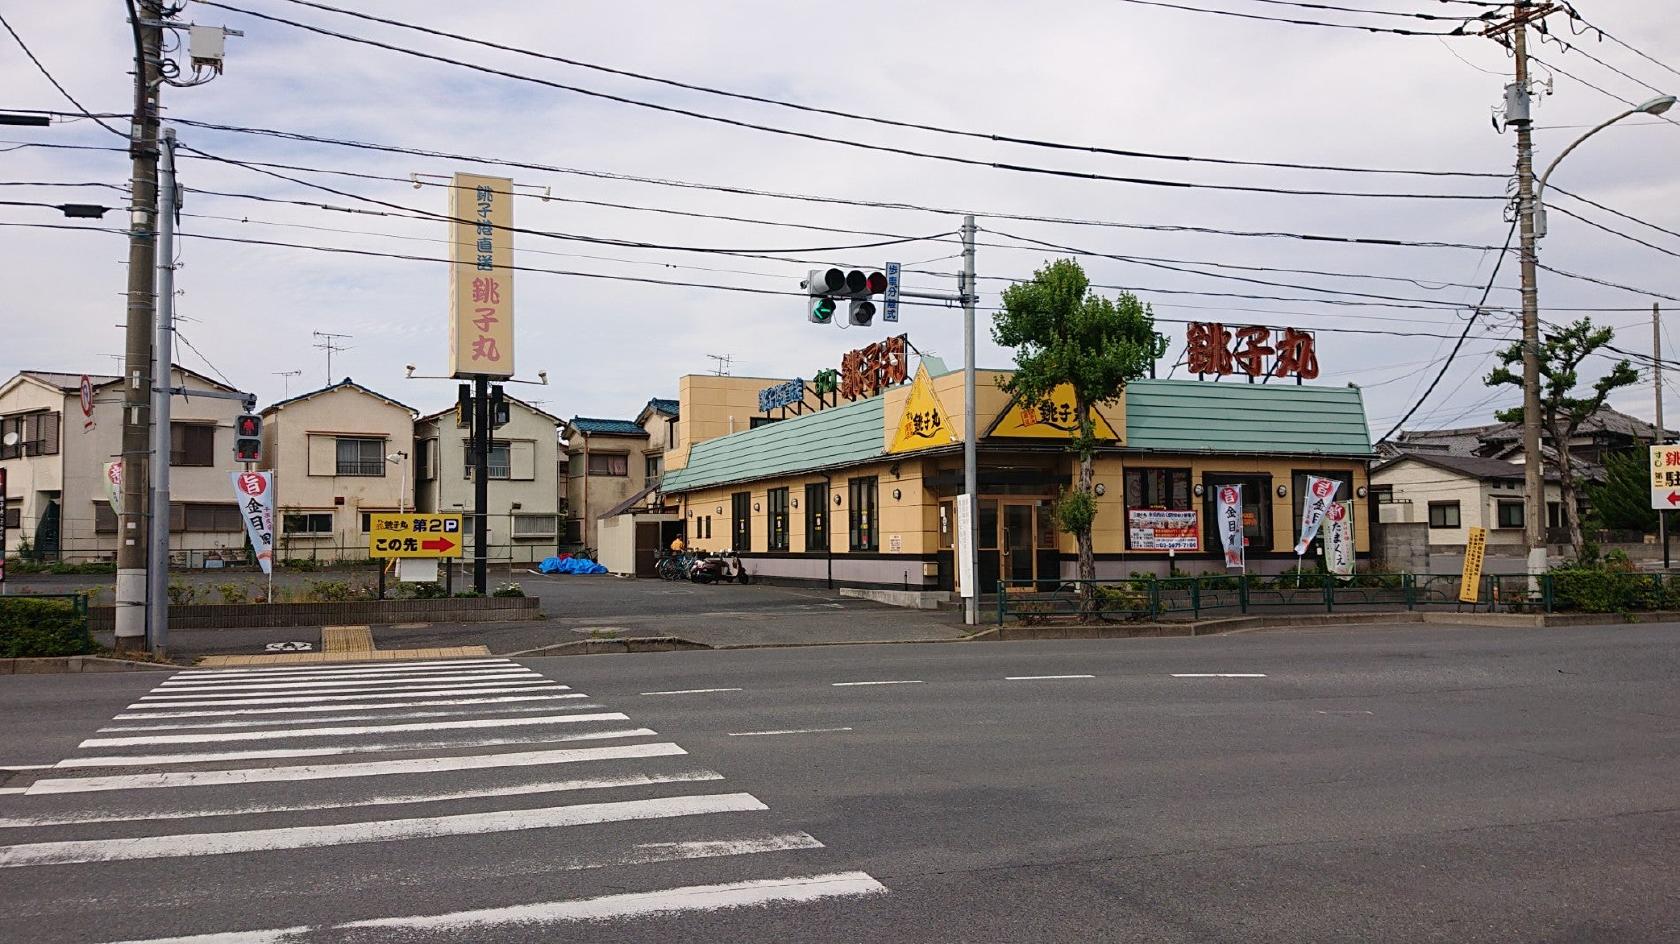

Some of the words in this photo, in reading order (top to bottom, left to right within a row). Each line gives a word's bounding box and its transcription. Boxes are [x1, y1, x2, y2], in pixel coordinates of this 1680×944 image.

[476, 184, 494, 272] 銚子港直送
[887, 264, 898, 320] 歩車分離式
[471, 276, 501, 362] 銚子丸
[1186, 321, 1320, 380] 銚子丸
[913, 408, 941, 432] 銚子丸
[1654, 451, 1663, 468] すし
[1654, 471, 1664, 488] 第二
[375, 537, 418, 552] この先
[1332, 521, 1346, 566] たまくえ
